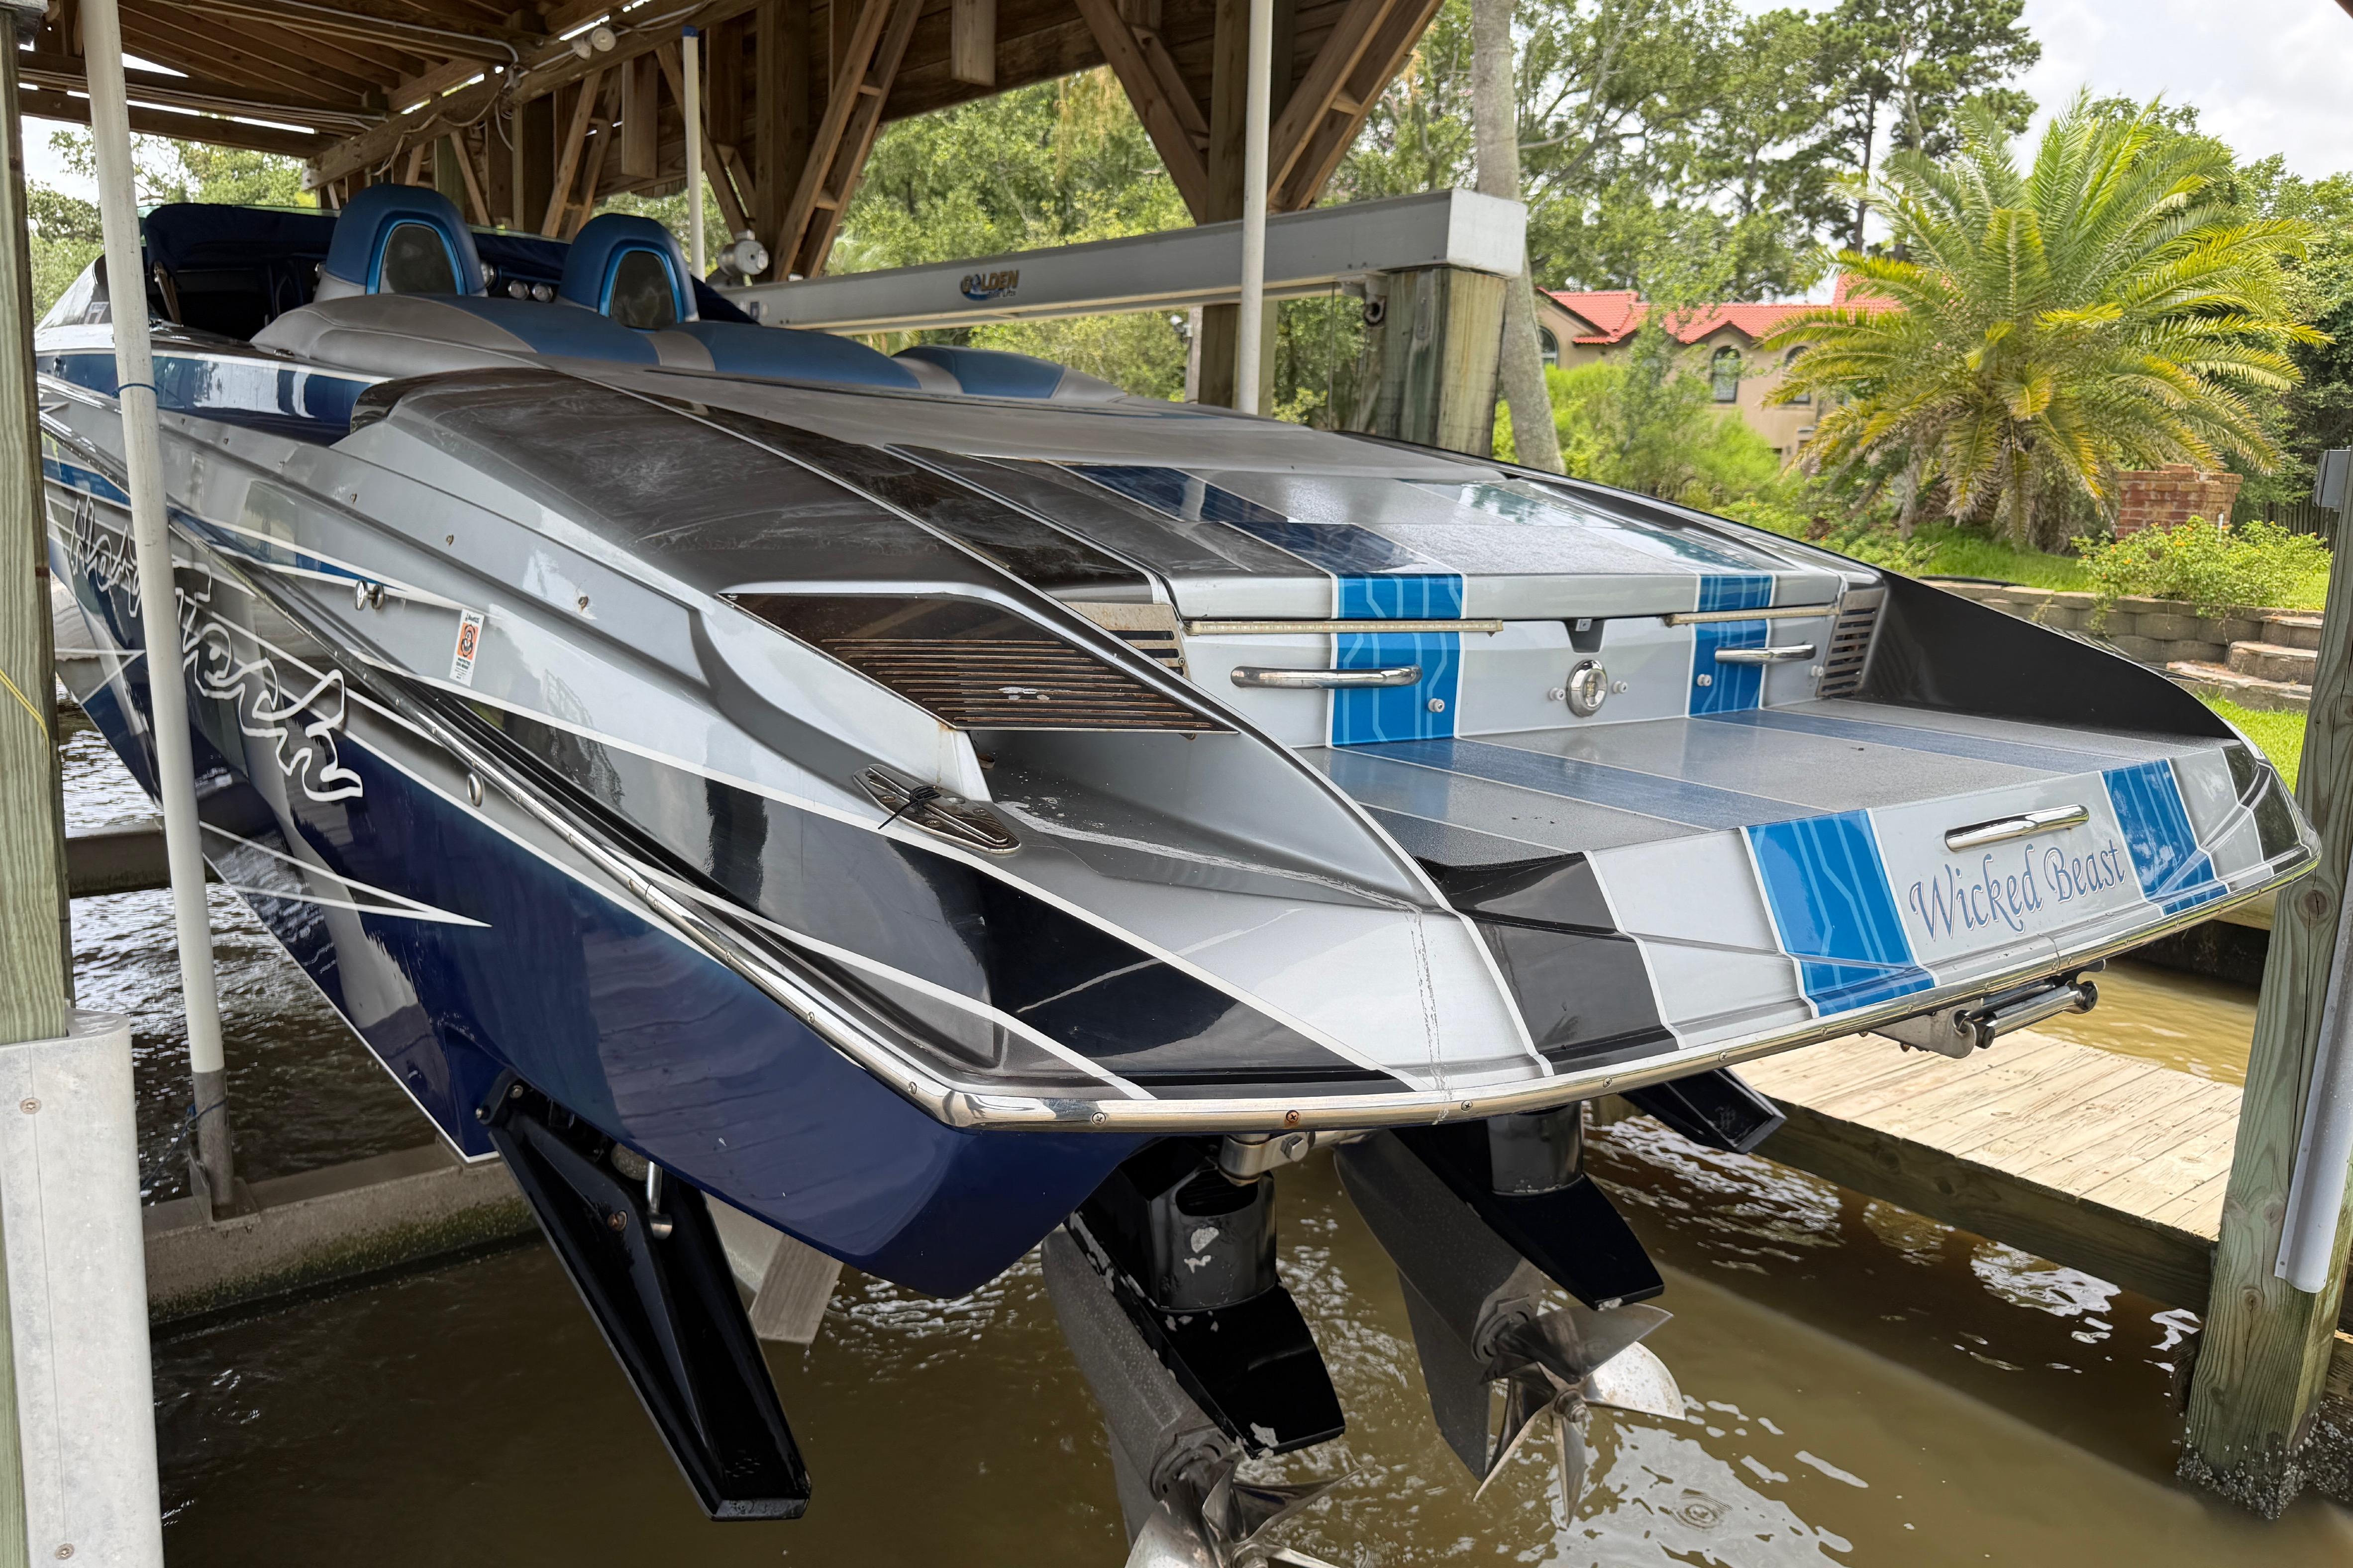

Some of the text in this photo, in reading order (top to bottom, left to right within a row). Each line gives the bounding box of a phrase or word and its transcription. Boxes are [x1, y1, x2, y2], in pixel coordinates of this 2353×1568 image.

[960, 269, 1019, 294] GOLDEN
[1909, 839, 2126, 942] Wicked Beast
